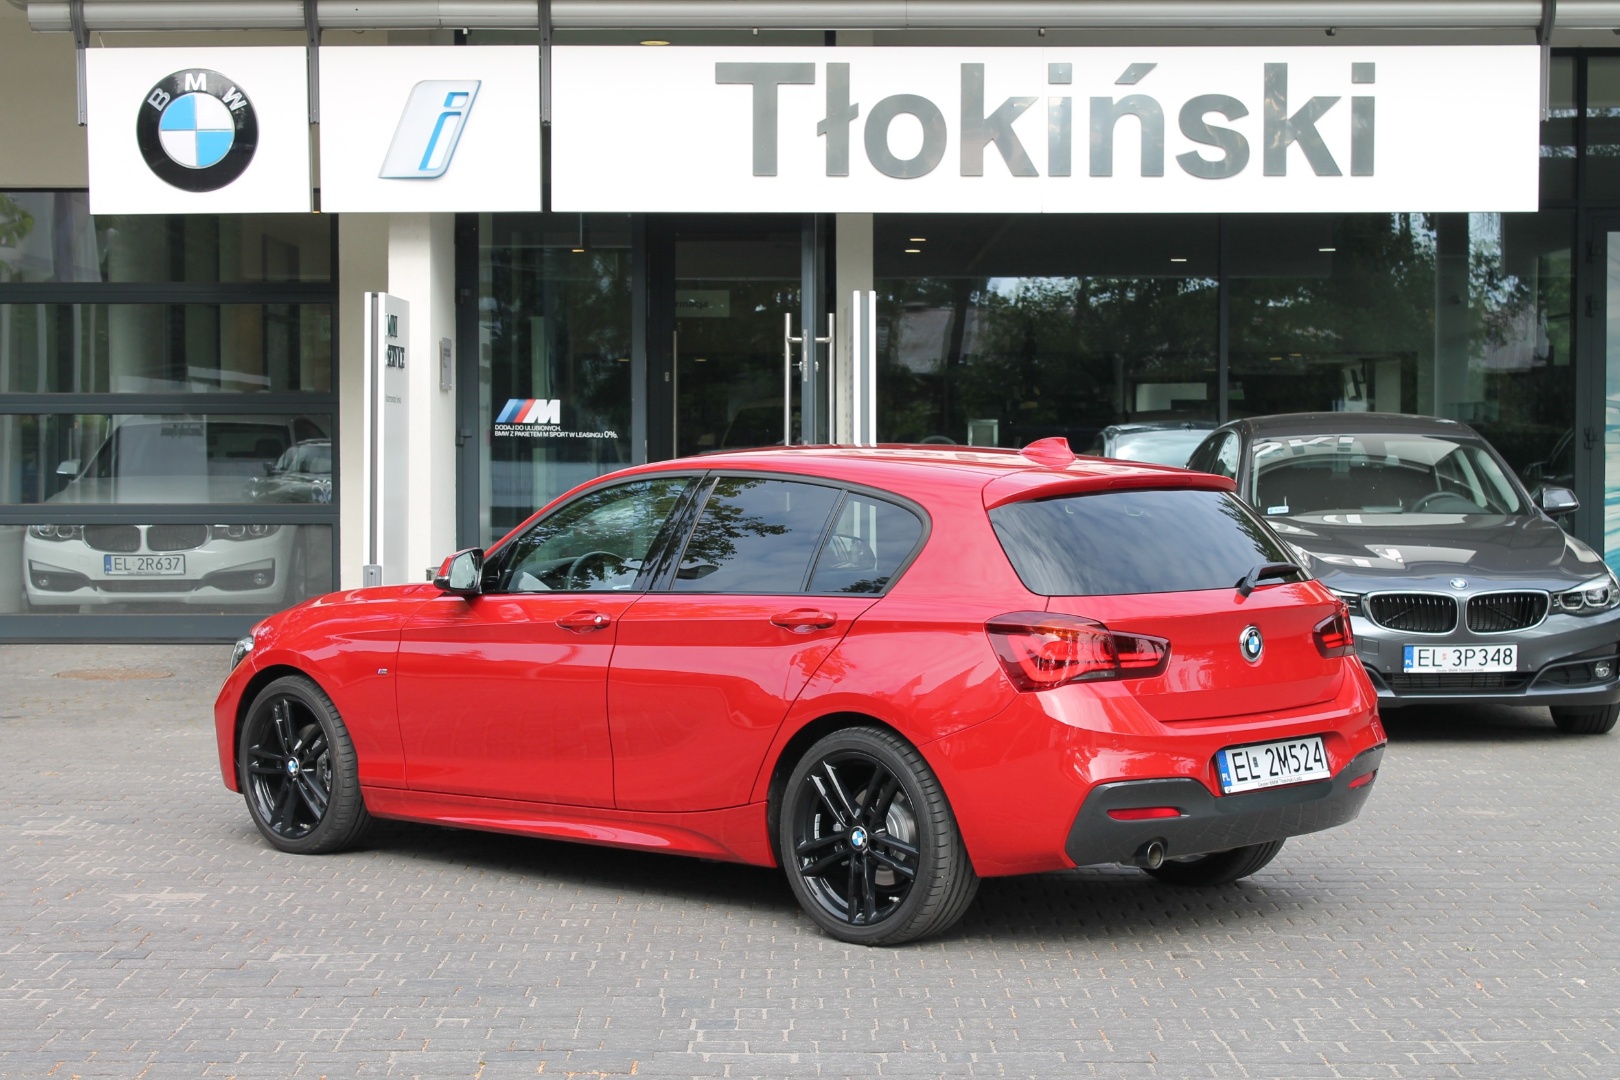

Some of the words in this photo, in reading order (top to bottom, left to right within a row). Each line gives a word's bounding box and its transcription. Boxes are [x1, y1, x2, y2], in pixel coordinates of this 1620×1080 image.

[147, 73, 248, 112] BMW
[418, 91, 470, 171] i
[715, 62, 1375, 180] Tłokiński
[114, 557, 131, 571] EL
[137, 557, 181, 571] 2R637
[1418, 649, 1442, 667] EL
[1452, 648, 1513, 667] 3P348
[1221, 772, 1231, 782] PL
[1232, 750, 1261, 782] EL
[1265, 741, 1325, 777] 2M524
